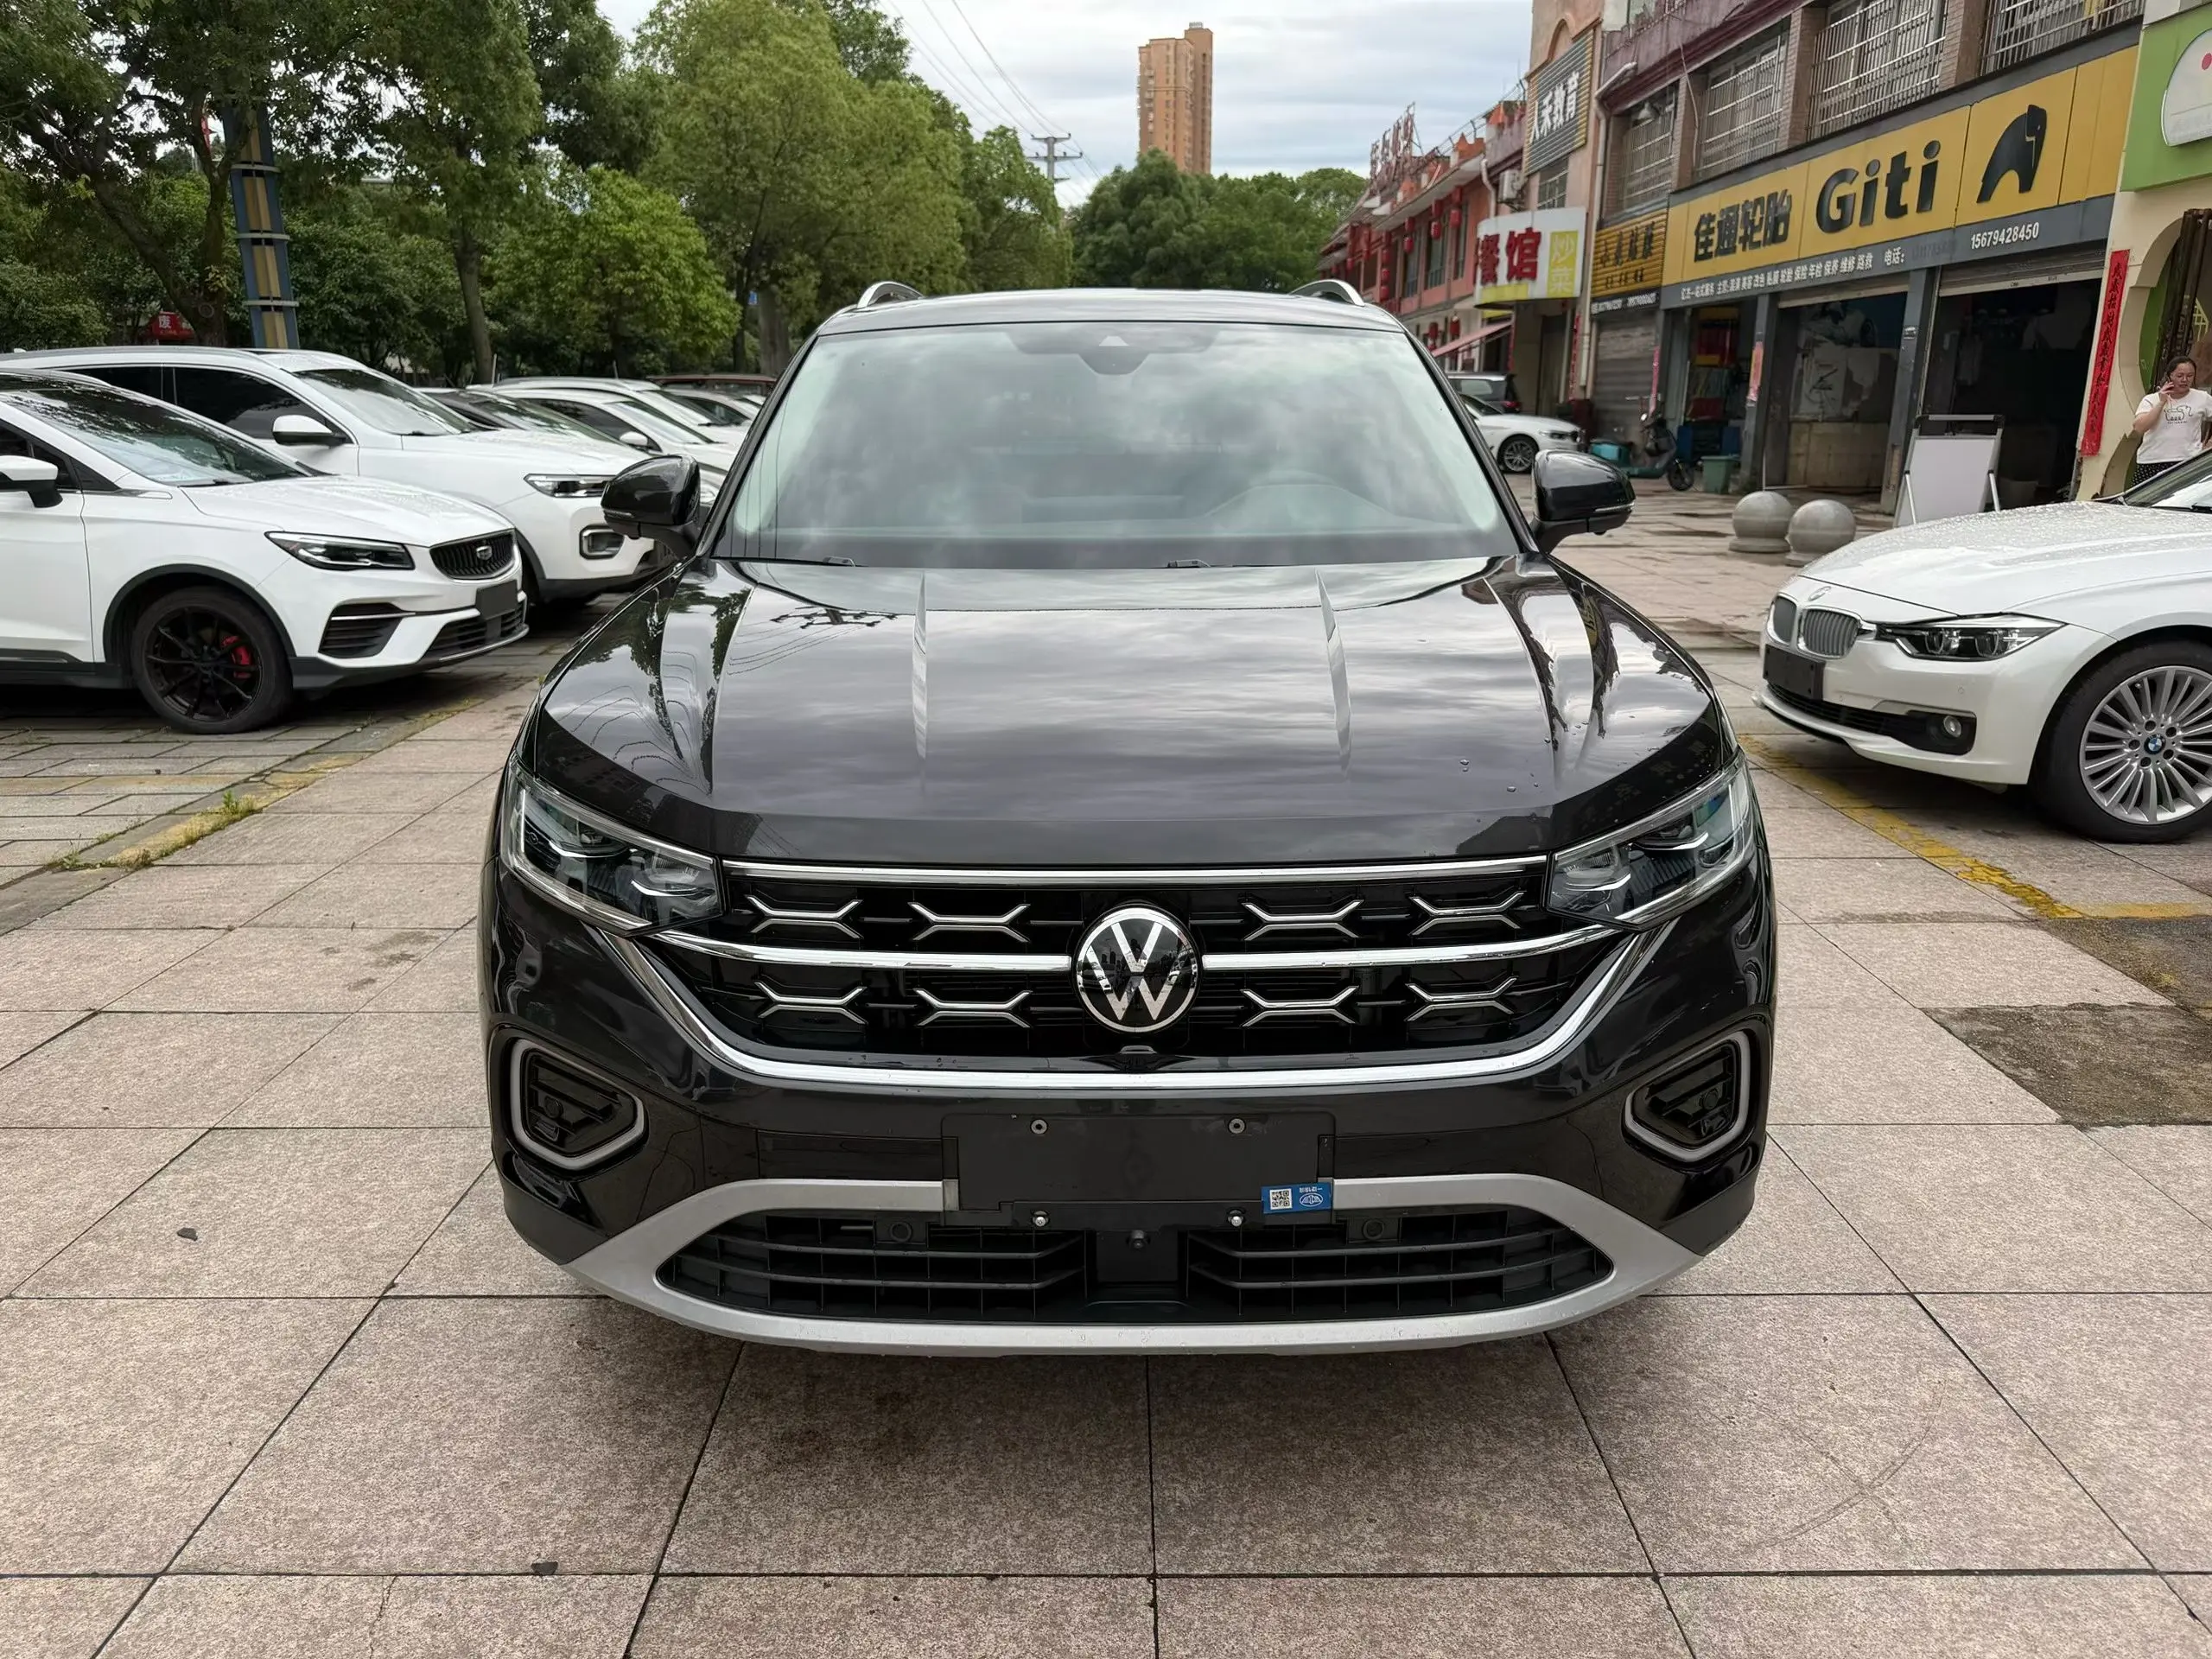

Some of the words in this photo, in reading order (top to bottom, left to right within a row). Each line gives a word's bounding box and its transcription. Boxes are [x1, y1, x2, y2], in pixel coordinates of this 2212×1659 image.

[1816, 140, 1941, 233] Giti
[1694, 189, 1792, 263] 佳通轮胎
[1971, 222, 2039, 249] 15679428450
[1551, 234, 1575, 293] 炒菜
